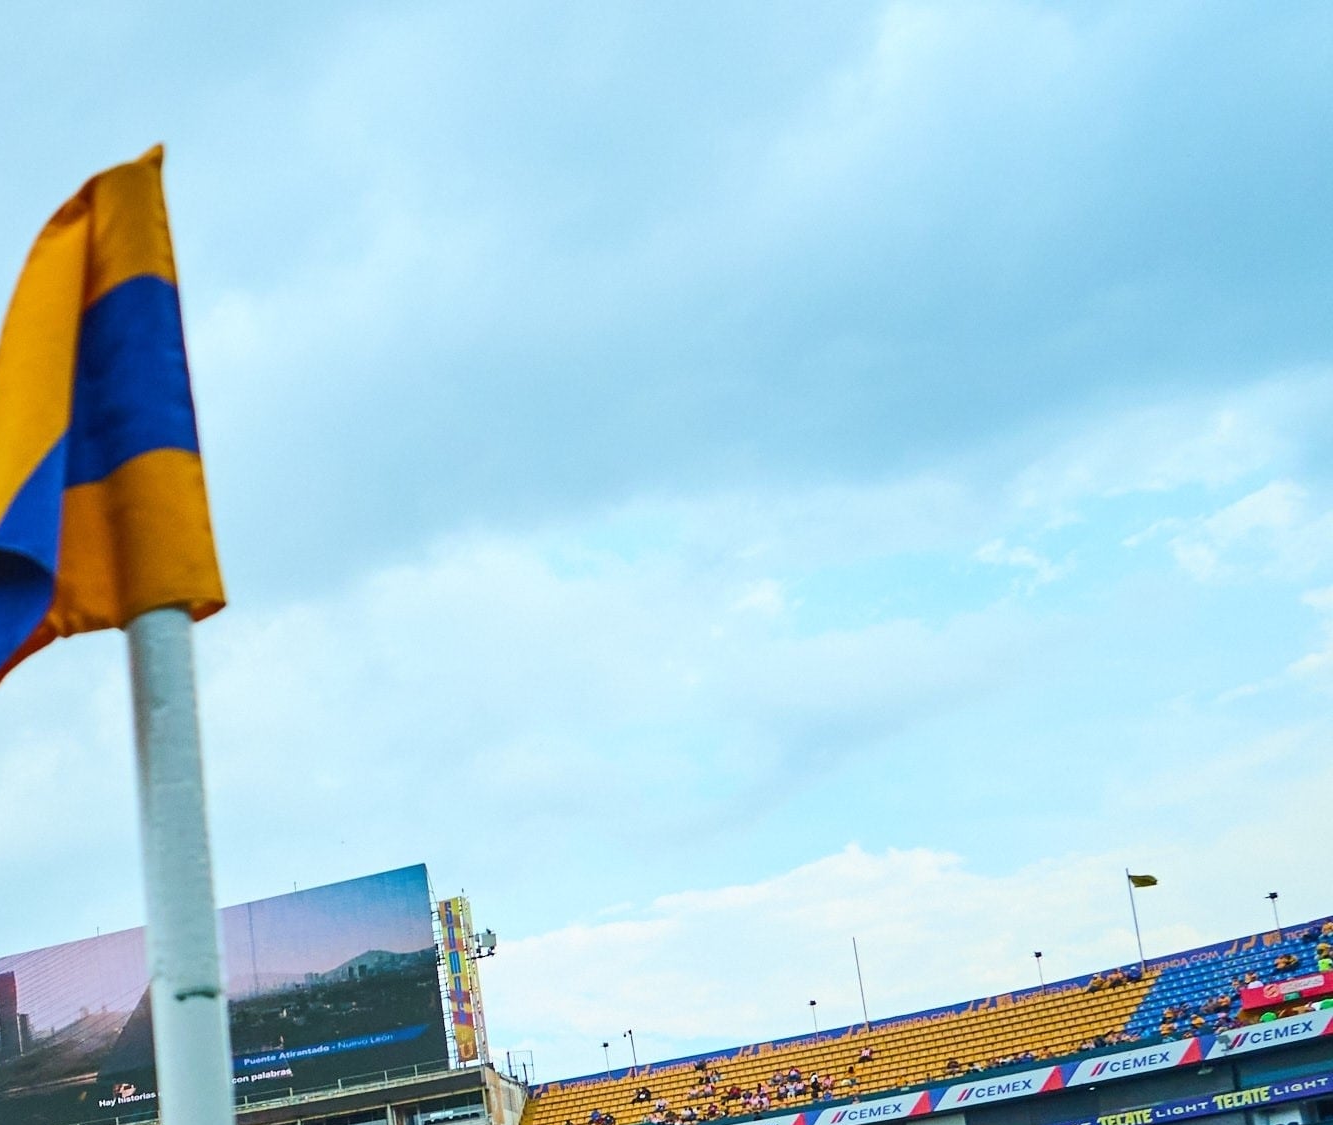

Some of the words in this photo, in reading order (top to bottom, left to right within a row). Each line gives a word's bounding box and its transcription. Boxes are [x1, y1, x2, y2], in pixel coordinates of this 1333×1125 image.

[1250, 1021, 1313, 1043] CEMEX
[244, 1055, 276, 1066] Puente
[279, 1045, 330, 1060] Atirantado
[338, 1038, 368, 1050] Nuevo
[370, 1034, 394, 1044] León
[1109, 1052, 1169, 1072] CEMEX
[231, 1075, 249, 1084] con
[251, 1067, 292, 1082] palabras
[975, 1079, 1032, 1098] CEMEX
[1212, 1085, 1271, 1110] TECATE
[1274, 1077, 1329, 1095] LIGHT
[99, 1097, 116, 1108] Hay
[118, 1091, 156, 1104] historias
[848, 1103, 901, 1121] CEMEX
[1156, 1102, 1208, 1117] LIGHT
